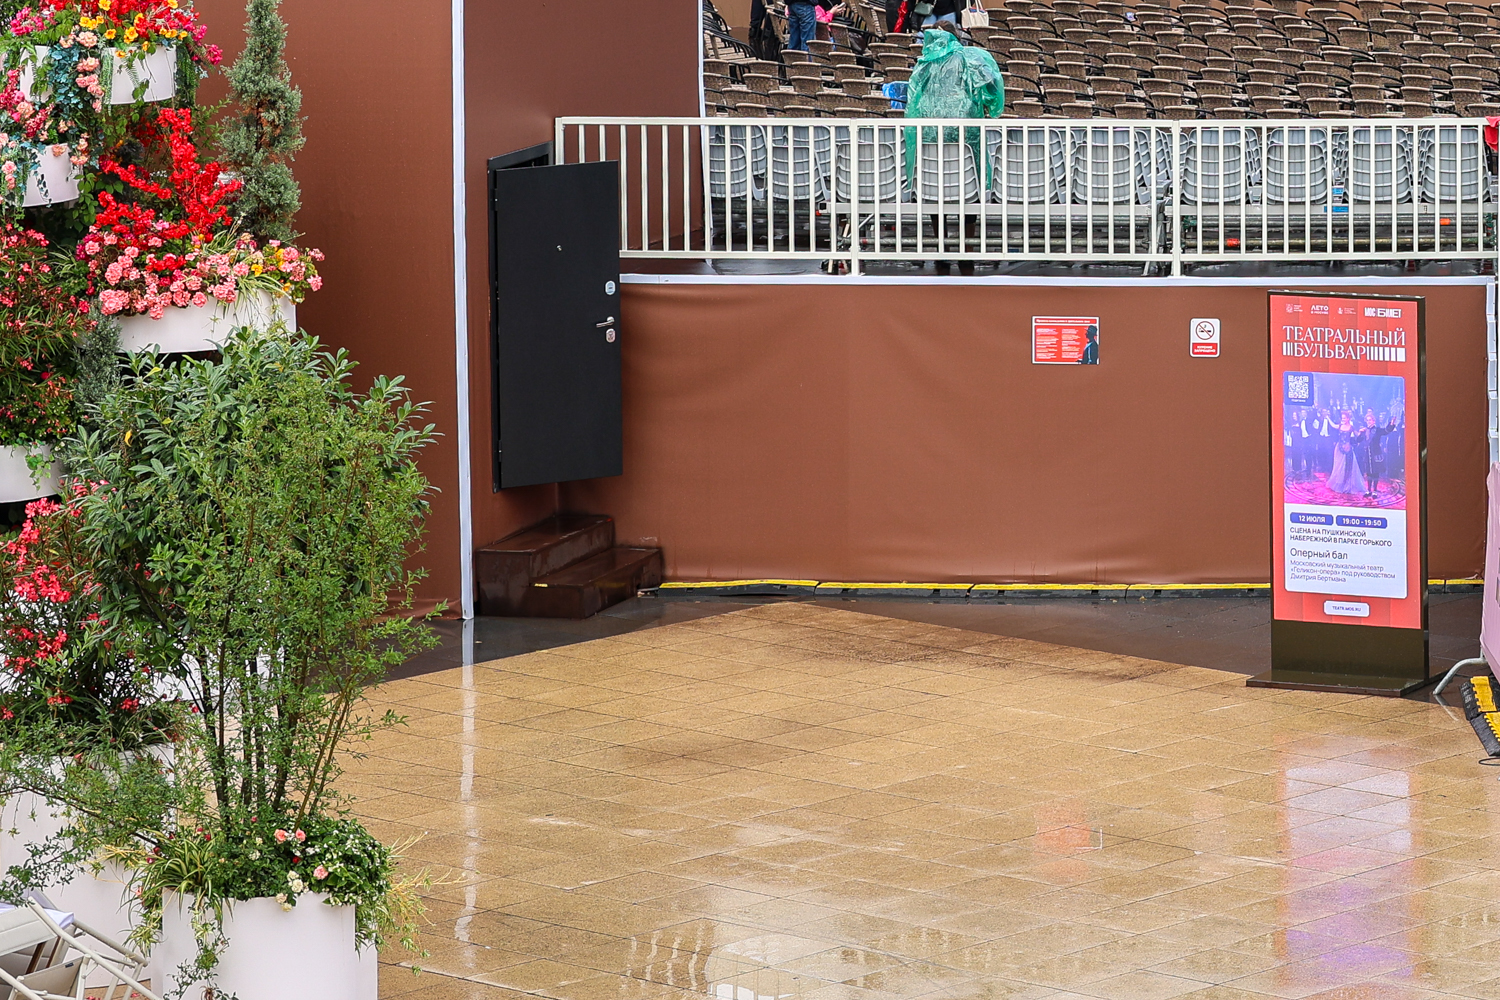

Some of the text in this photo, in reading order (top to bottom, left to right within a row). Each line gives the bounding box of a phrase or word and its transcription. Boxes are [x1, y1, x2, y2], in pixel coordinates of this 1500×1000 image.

[1282, 325, 1406, 346] ТЕАТРАЛЬНЫЙ
[1294, 342, 1366, 360] БУЛЬВАР
[1322, 529, 1366, 537] ПУШКИНСКОЙ
[1290, 535, 1333, 543] НАБЕРЕЖНОЙ
[1359, 539, 1392, 547] ГОРЬКОГО
[1290, 547, 1348, 560] Оперный бал
